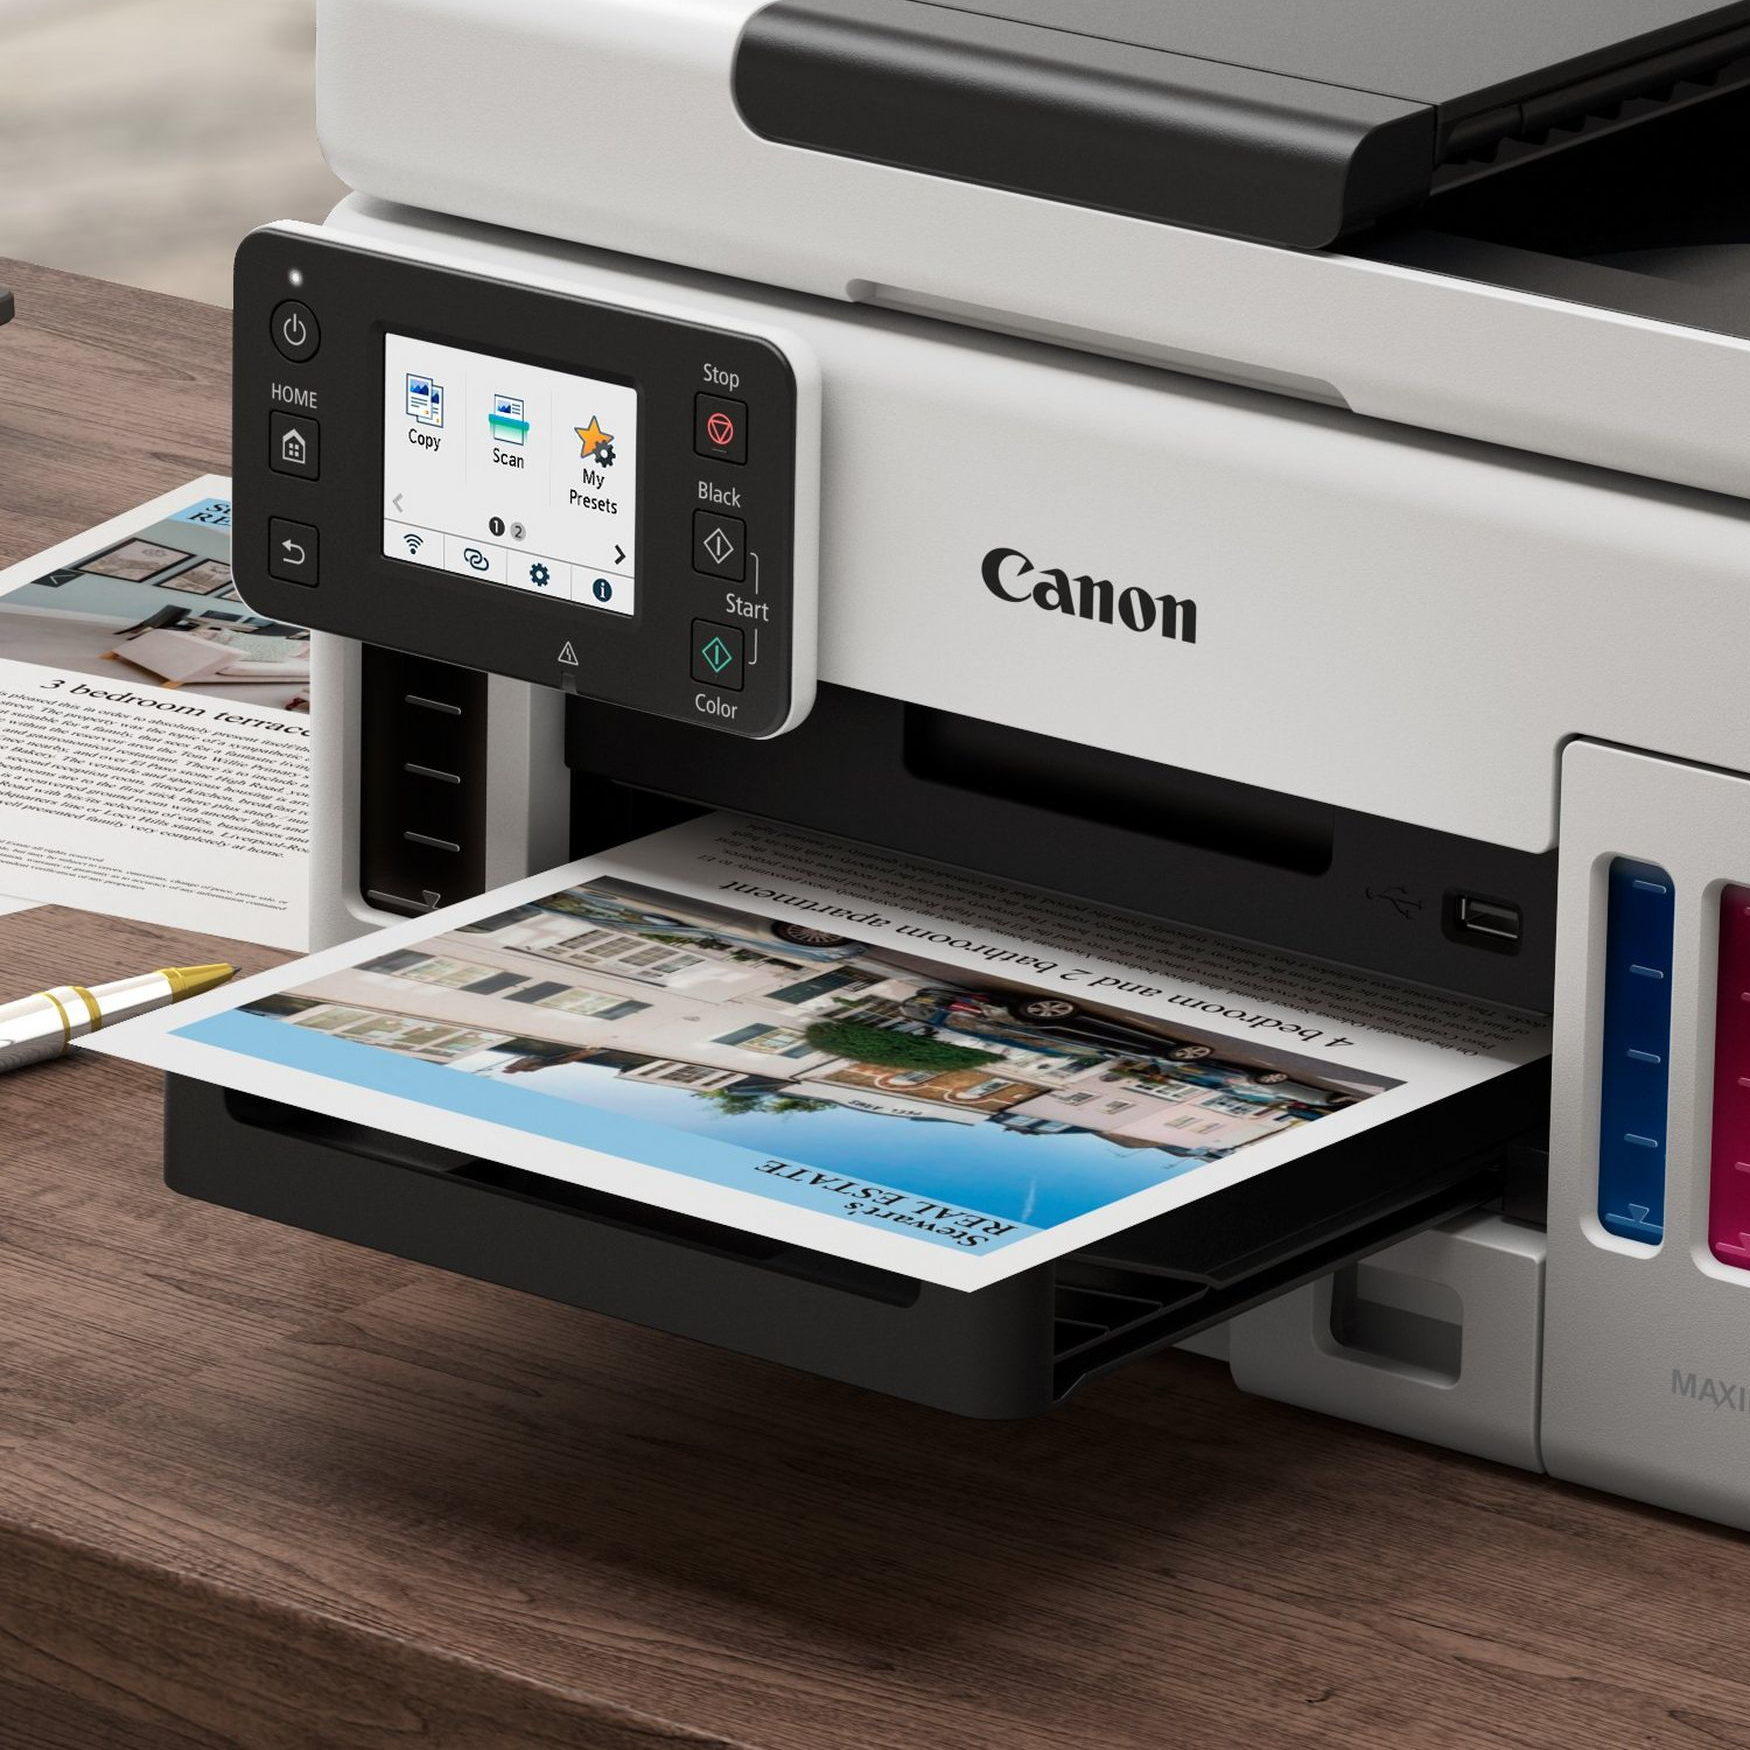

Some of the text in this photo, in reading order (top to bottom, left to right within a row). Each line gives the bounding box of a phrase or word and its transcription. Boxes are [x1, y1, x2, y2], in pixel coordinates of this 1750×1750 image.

[702, 362, 740, 390] Stop
[271, 381, 318, 410] HOME
[408, 428, 441, 452] Copy
[492, 447, 525, 469] Scan
[582, 468, 605, 490] My
[569, 488, 618, 515] Presets
[698, 481, 741, 508] Black
[187, 512, 231, 526] RE
[725, 592, 769, 623] Start
[981, 547, 1197, 644] Canon
[40, 679, 66, 690] 3
[70, 684, 205, 717] bedroom
[694, 693, 739, 720] Color
[63, 712, 117, 725] property
[718, 880, 1355, 1048] 4 bedroom and 2 bathroom apartment
[753, 1159, 1018, 1237] REAL ESTATE
[843, 1201, 989, 1248] Stewart's
